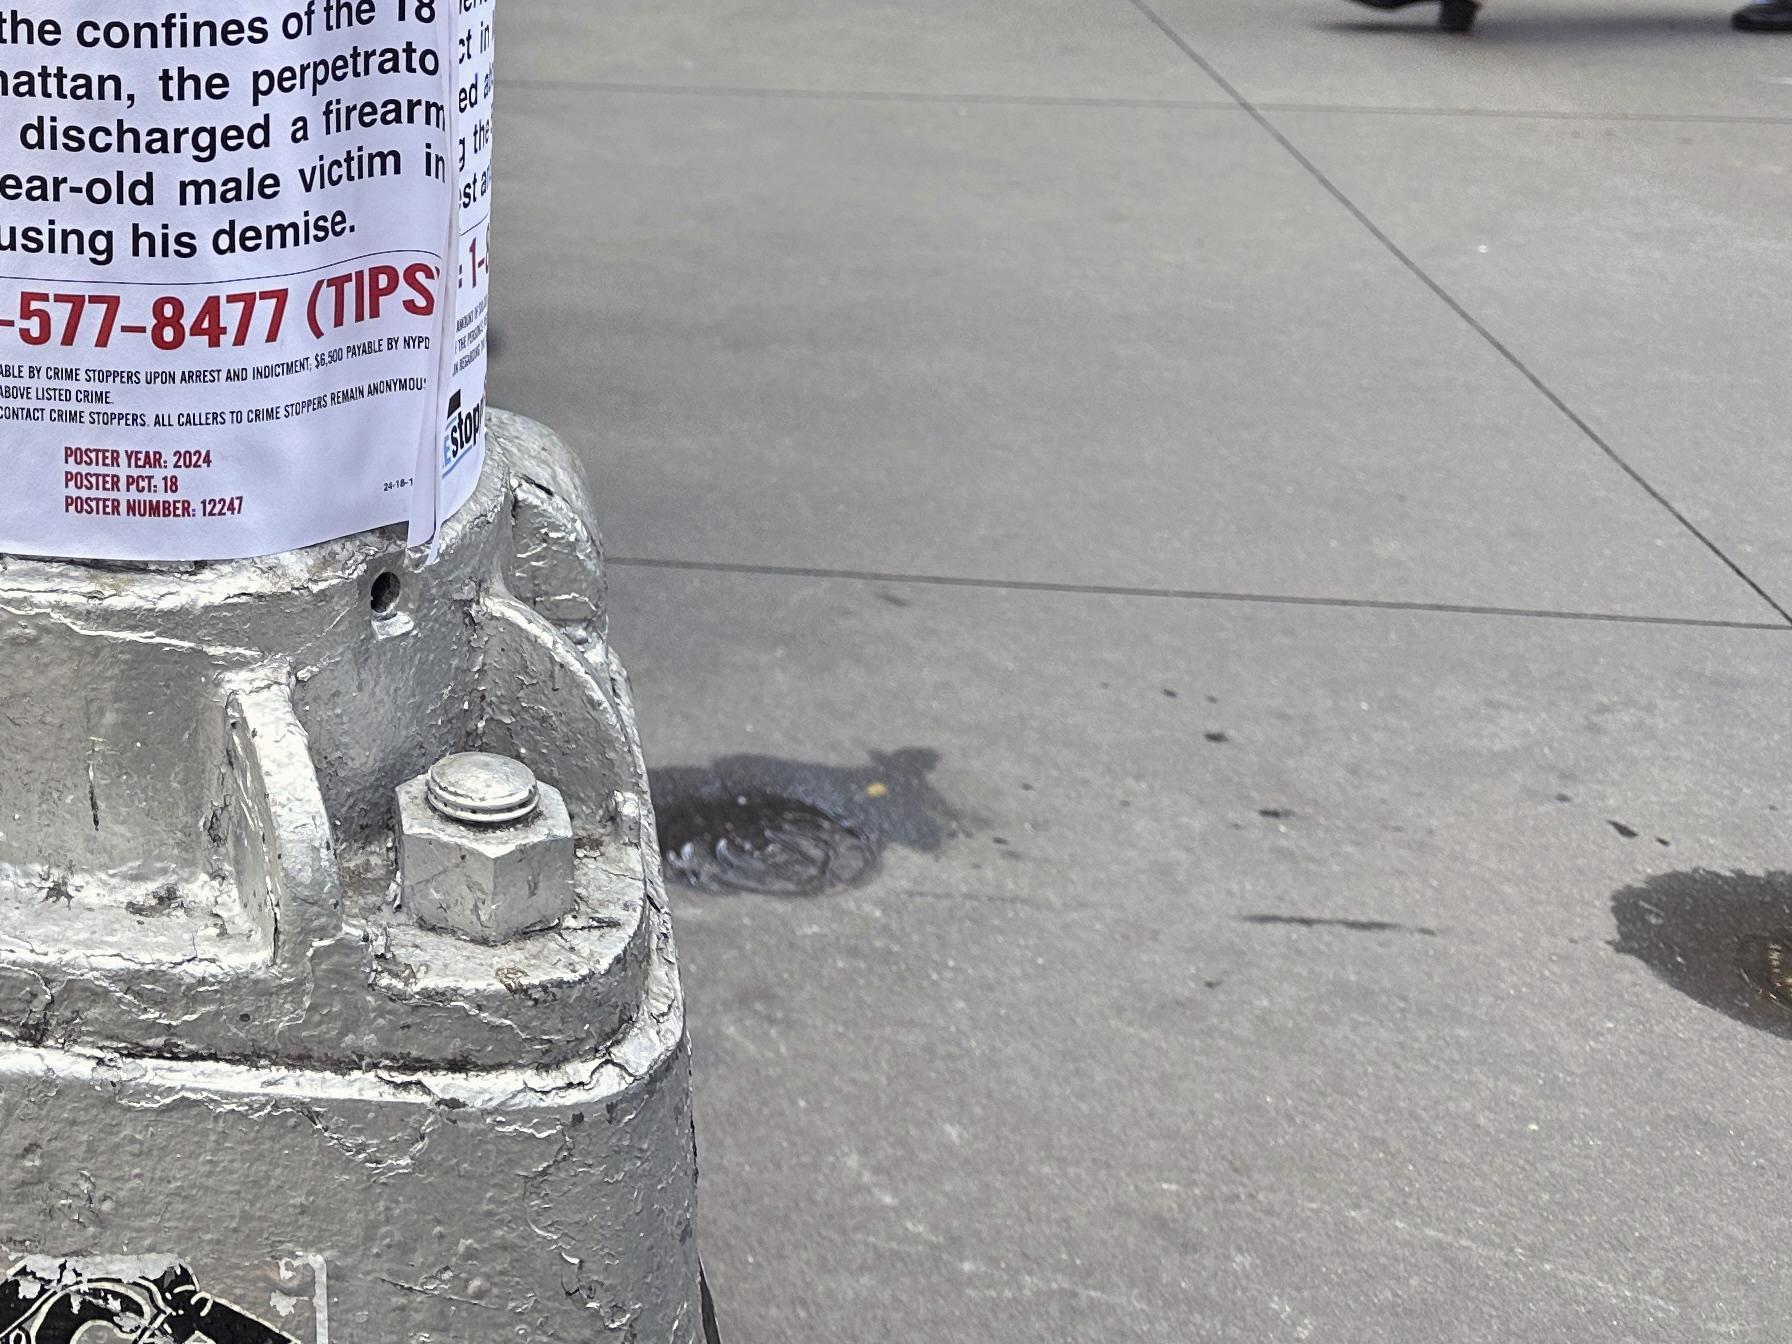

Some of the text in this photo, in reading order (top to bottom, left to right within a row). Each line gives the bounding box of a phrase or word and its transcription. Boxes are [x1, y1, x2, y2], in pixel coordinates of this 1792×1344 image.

[76, 12, 268, 48] confines
[282, 0, 316, 40] of
[159, 66, 229, 101] the
[253, 41, 439, 106] perpetrato
[20, 113, 269, 162] discharged
[291, 115, 308, 144] a
[179, 167, 280, 206] male
[299, 145, 400, 193] victim
[425, 143, 445, 183] in
[132, 223, 197, 258] his
[212, 209, 355, 255] demise.
[28, 365, 42, 380] BY
[46, 366, 80, 382] CRIME
[85, 369, 141, 385] STOPPERS
[145, 370, 176, 385] UPON
[180, 369, 222, 384] ARREST
[226, 368, 247, 382] AND
[315, 347, 343, 369] $6,500
[346, 338, 383, 359] PAYABLE
[387, 336, 399, 351] BY
[403, 335, 430, 350] NYPD
[36, 387, 71, 402] LISTED
[76, 389, 114, 404] CRIME.
[50, 409, 85, 424] CRIME
[89, 411, 149, 427] STOPPERS.
[154, 414, 174, 427] ALL
[178, 412, 226, 426] CALLERS
[229, 410, 242, 424] TO
[247, 405, 280, 423] CRIME
[284, 394, 327, 419] STOPPERS
[330, 385, 364, 406] REMAIN
[64, 446, 212, 469] POSTER YEAR: 2024
[65, 471, 179, 494] POSTER PCT: 18
[65, 495, 243, 518] POSTER NUMBER: 12247
